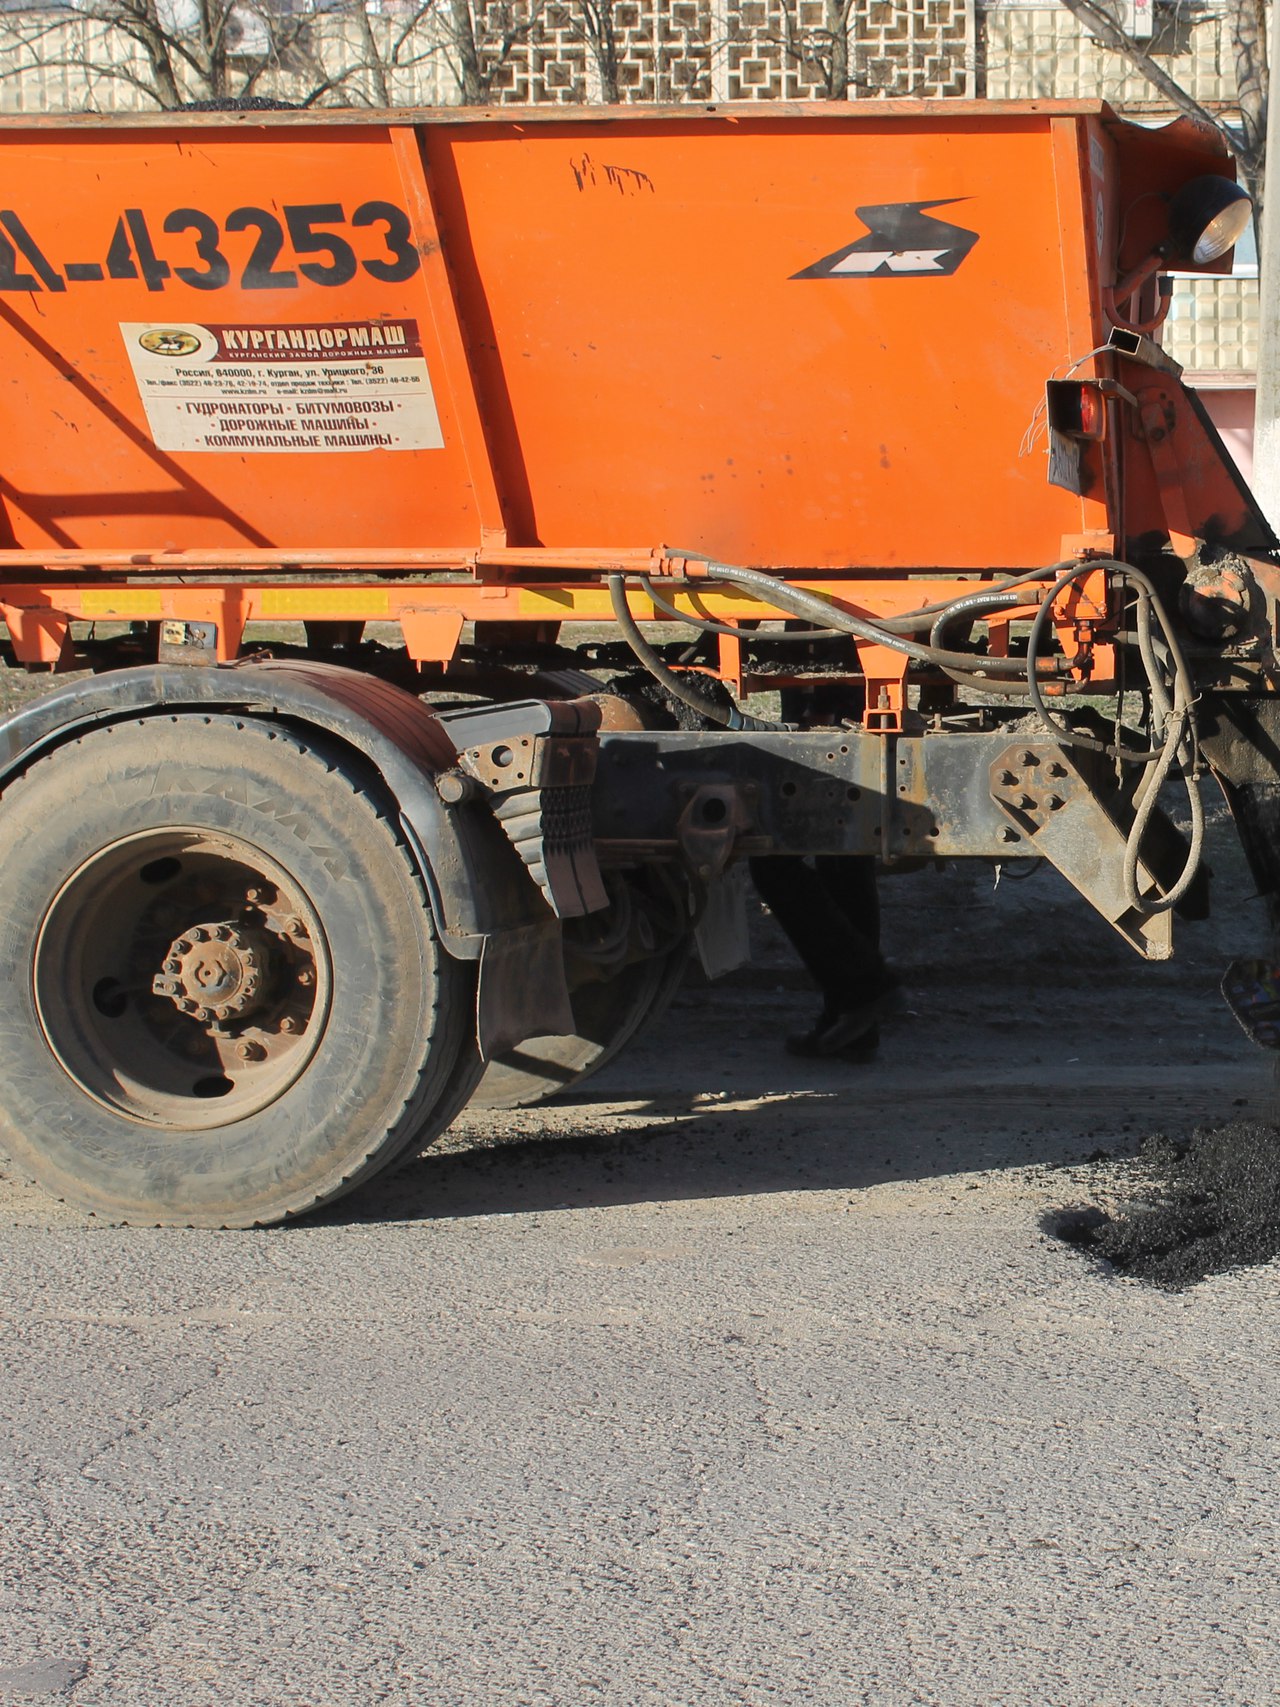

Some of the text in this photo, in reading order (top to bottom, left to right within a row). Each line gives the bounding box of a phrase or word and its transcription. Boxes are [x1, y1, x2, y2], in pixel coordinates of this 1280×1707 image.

[222, 325, 406, 352] КУРГАНДОРМАШ
[322, 350, 373, 358] ДОРОЖНЫХ
[258, 369, 264, 377] г.
[267, 368, 302, 378] Курган,
[305, 369, 320, 378] ул.
[322, 366, 369, 377] Урицкого,
[186, 399, 394, 416] ГУДРОНАТОРЫ БИТУМОВОЗЫ
[219, 417, 369, 433] ДОРОЖНЫЕ МАШИНЫ
[204, 433, 393, 448] КОММУНАЛЬНЫЕ МАШИНЫ
